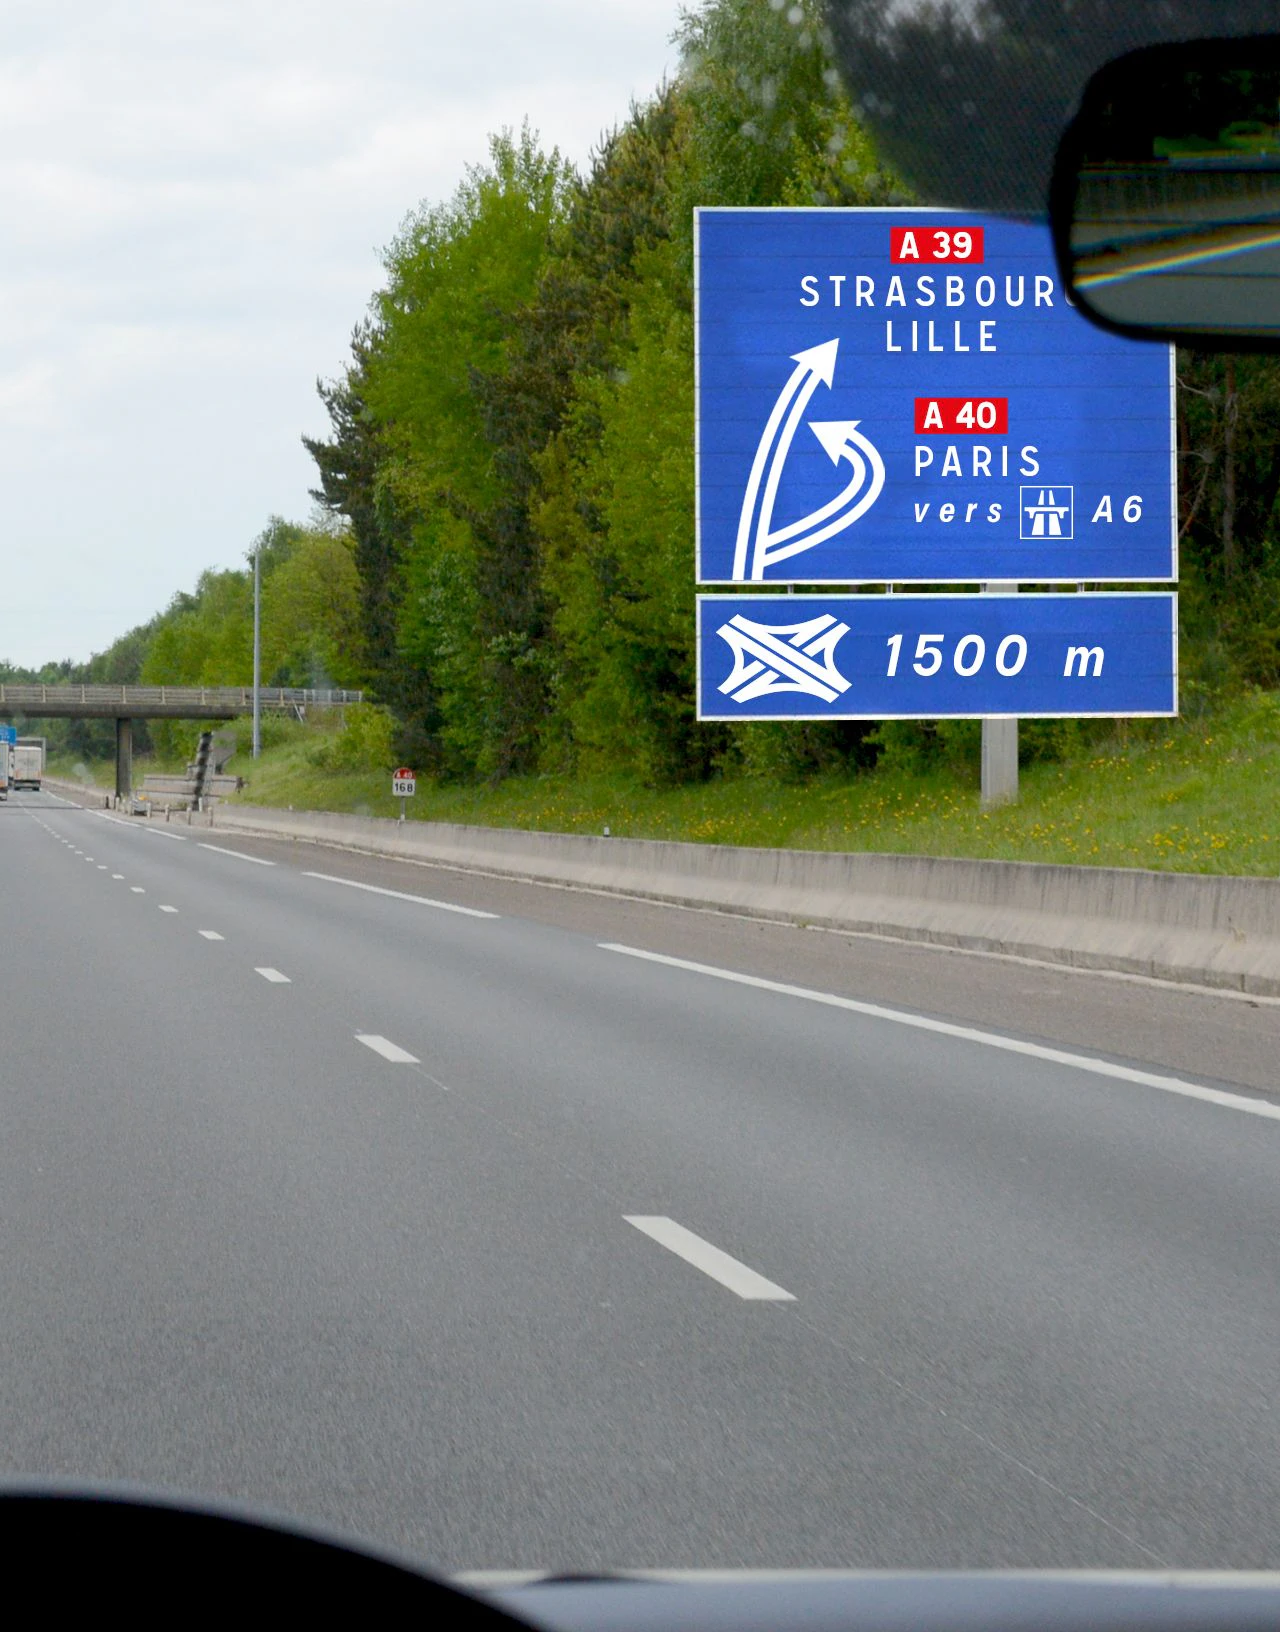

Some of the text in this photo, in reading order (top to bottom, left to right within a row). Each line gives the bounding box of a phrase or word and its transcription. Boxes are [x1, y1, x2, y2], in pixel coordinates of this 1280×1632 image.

[900, 232, 972, 258] A 39
[800, 276, 1076, 306] STRASBOUR
[887, 321, 996, 351] LILLE
[924, 402, 996, 428] A 40
[916, 446, 1039, 476] PARIS
[915, 496, 1142, 522] vers A6
[887, 635, 1104, 676] 1500 m
[395, 782, 413, 793] 168
